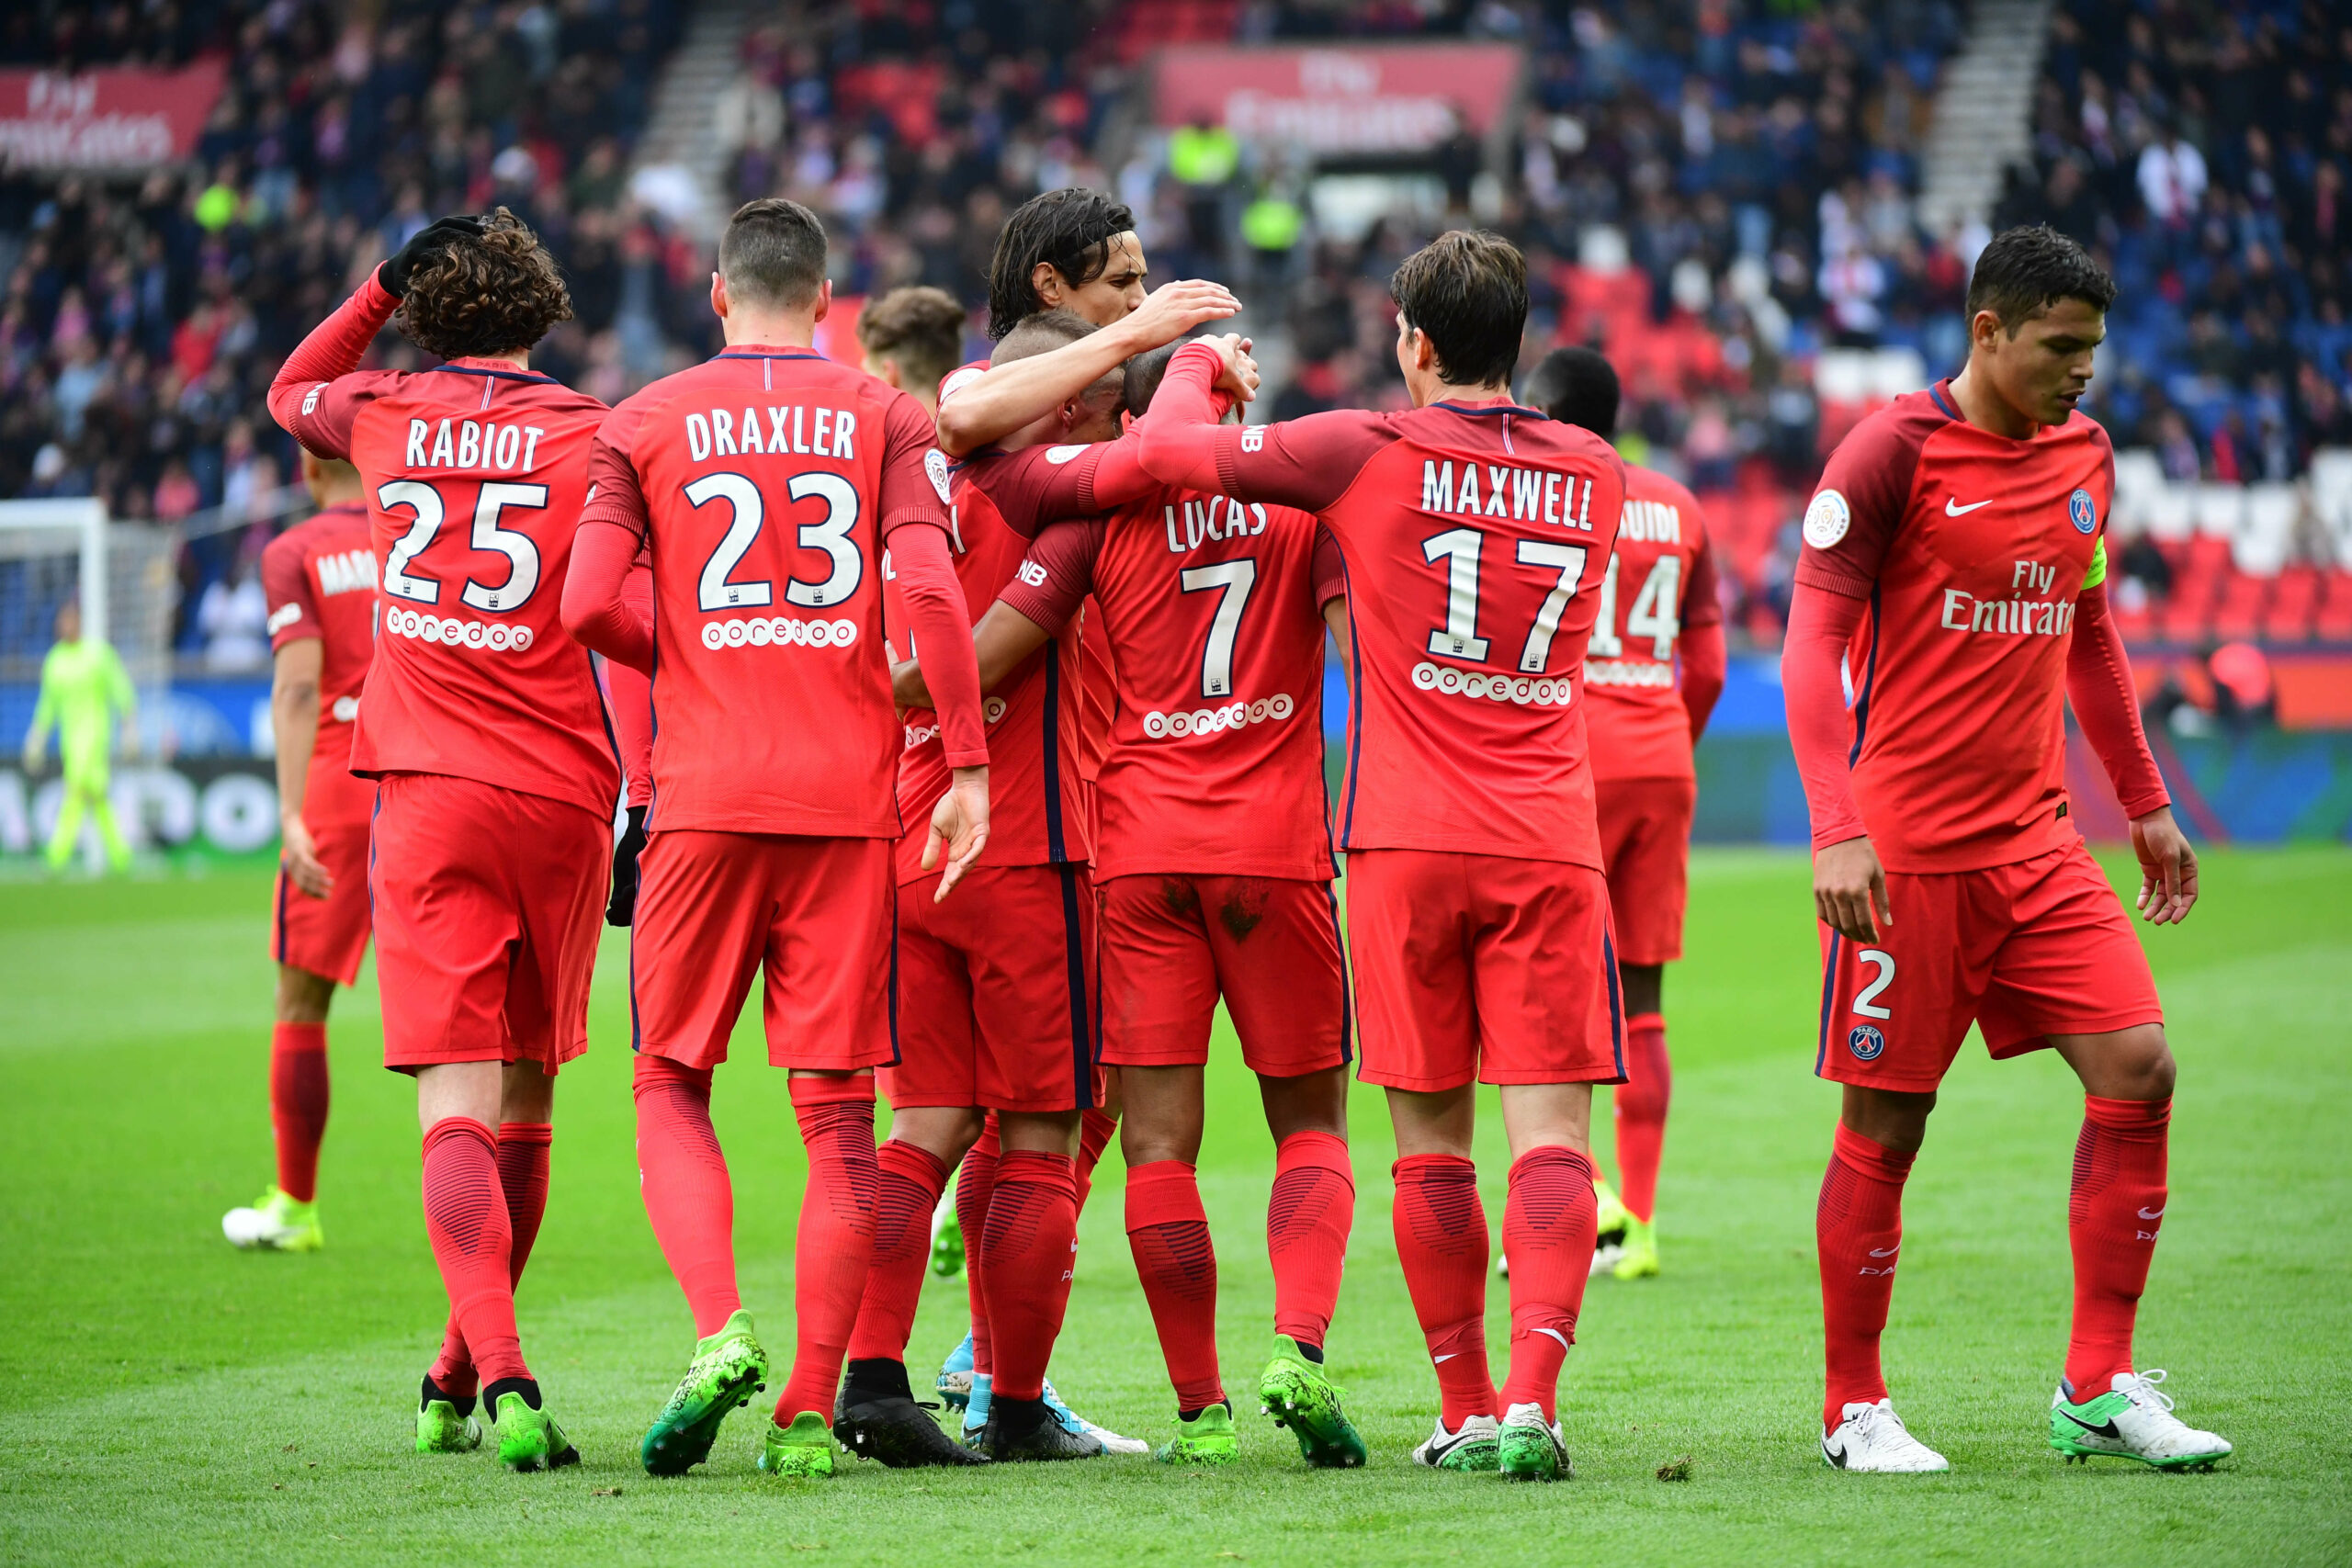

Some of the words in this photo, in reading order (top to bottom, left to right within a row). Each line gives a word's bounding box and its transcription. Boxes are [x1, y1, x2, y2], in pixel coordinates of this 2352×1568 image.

[476, 360, 510, 370] PARIS
[301, 381, 330, 416] NB
[405, 418, 544, 472] RABIOT
[685, 405, 856, 462] DRAXLER
[1241, 423, 1268, 453] NB
[1421, 459, 1594, 532] MAXWELL
[377, 479, 550, 614] 25
[683, 470, 864, 613] 23
[1164, 494, 1268, 553] LUCAS
[1014, 558, 1048, 587] NB
[2011, 560, 2056, 595] Fly
[1419, 526, 1588, 674] 17
[1587, 551, 1680, 661] 14
[387, 605, 534, 651] ooredoo
[701, 616, 857, 650] ooredoo
[1179, 557, 1258, 699] 7
[1411, 661, 1571, 705] ooredoo
[1143, 693, 1294, 739] ooredoo
[1852, 949, 1896, 1021] 2
[1856, 1027, 1880, 1039] PARIS
[1504, 1431, 1544, 1441] TIEMPO
